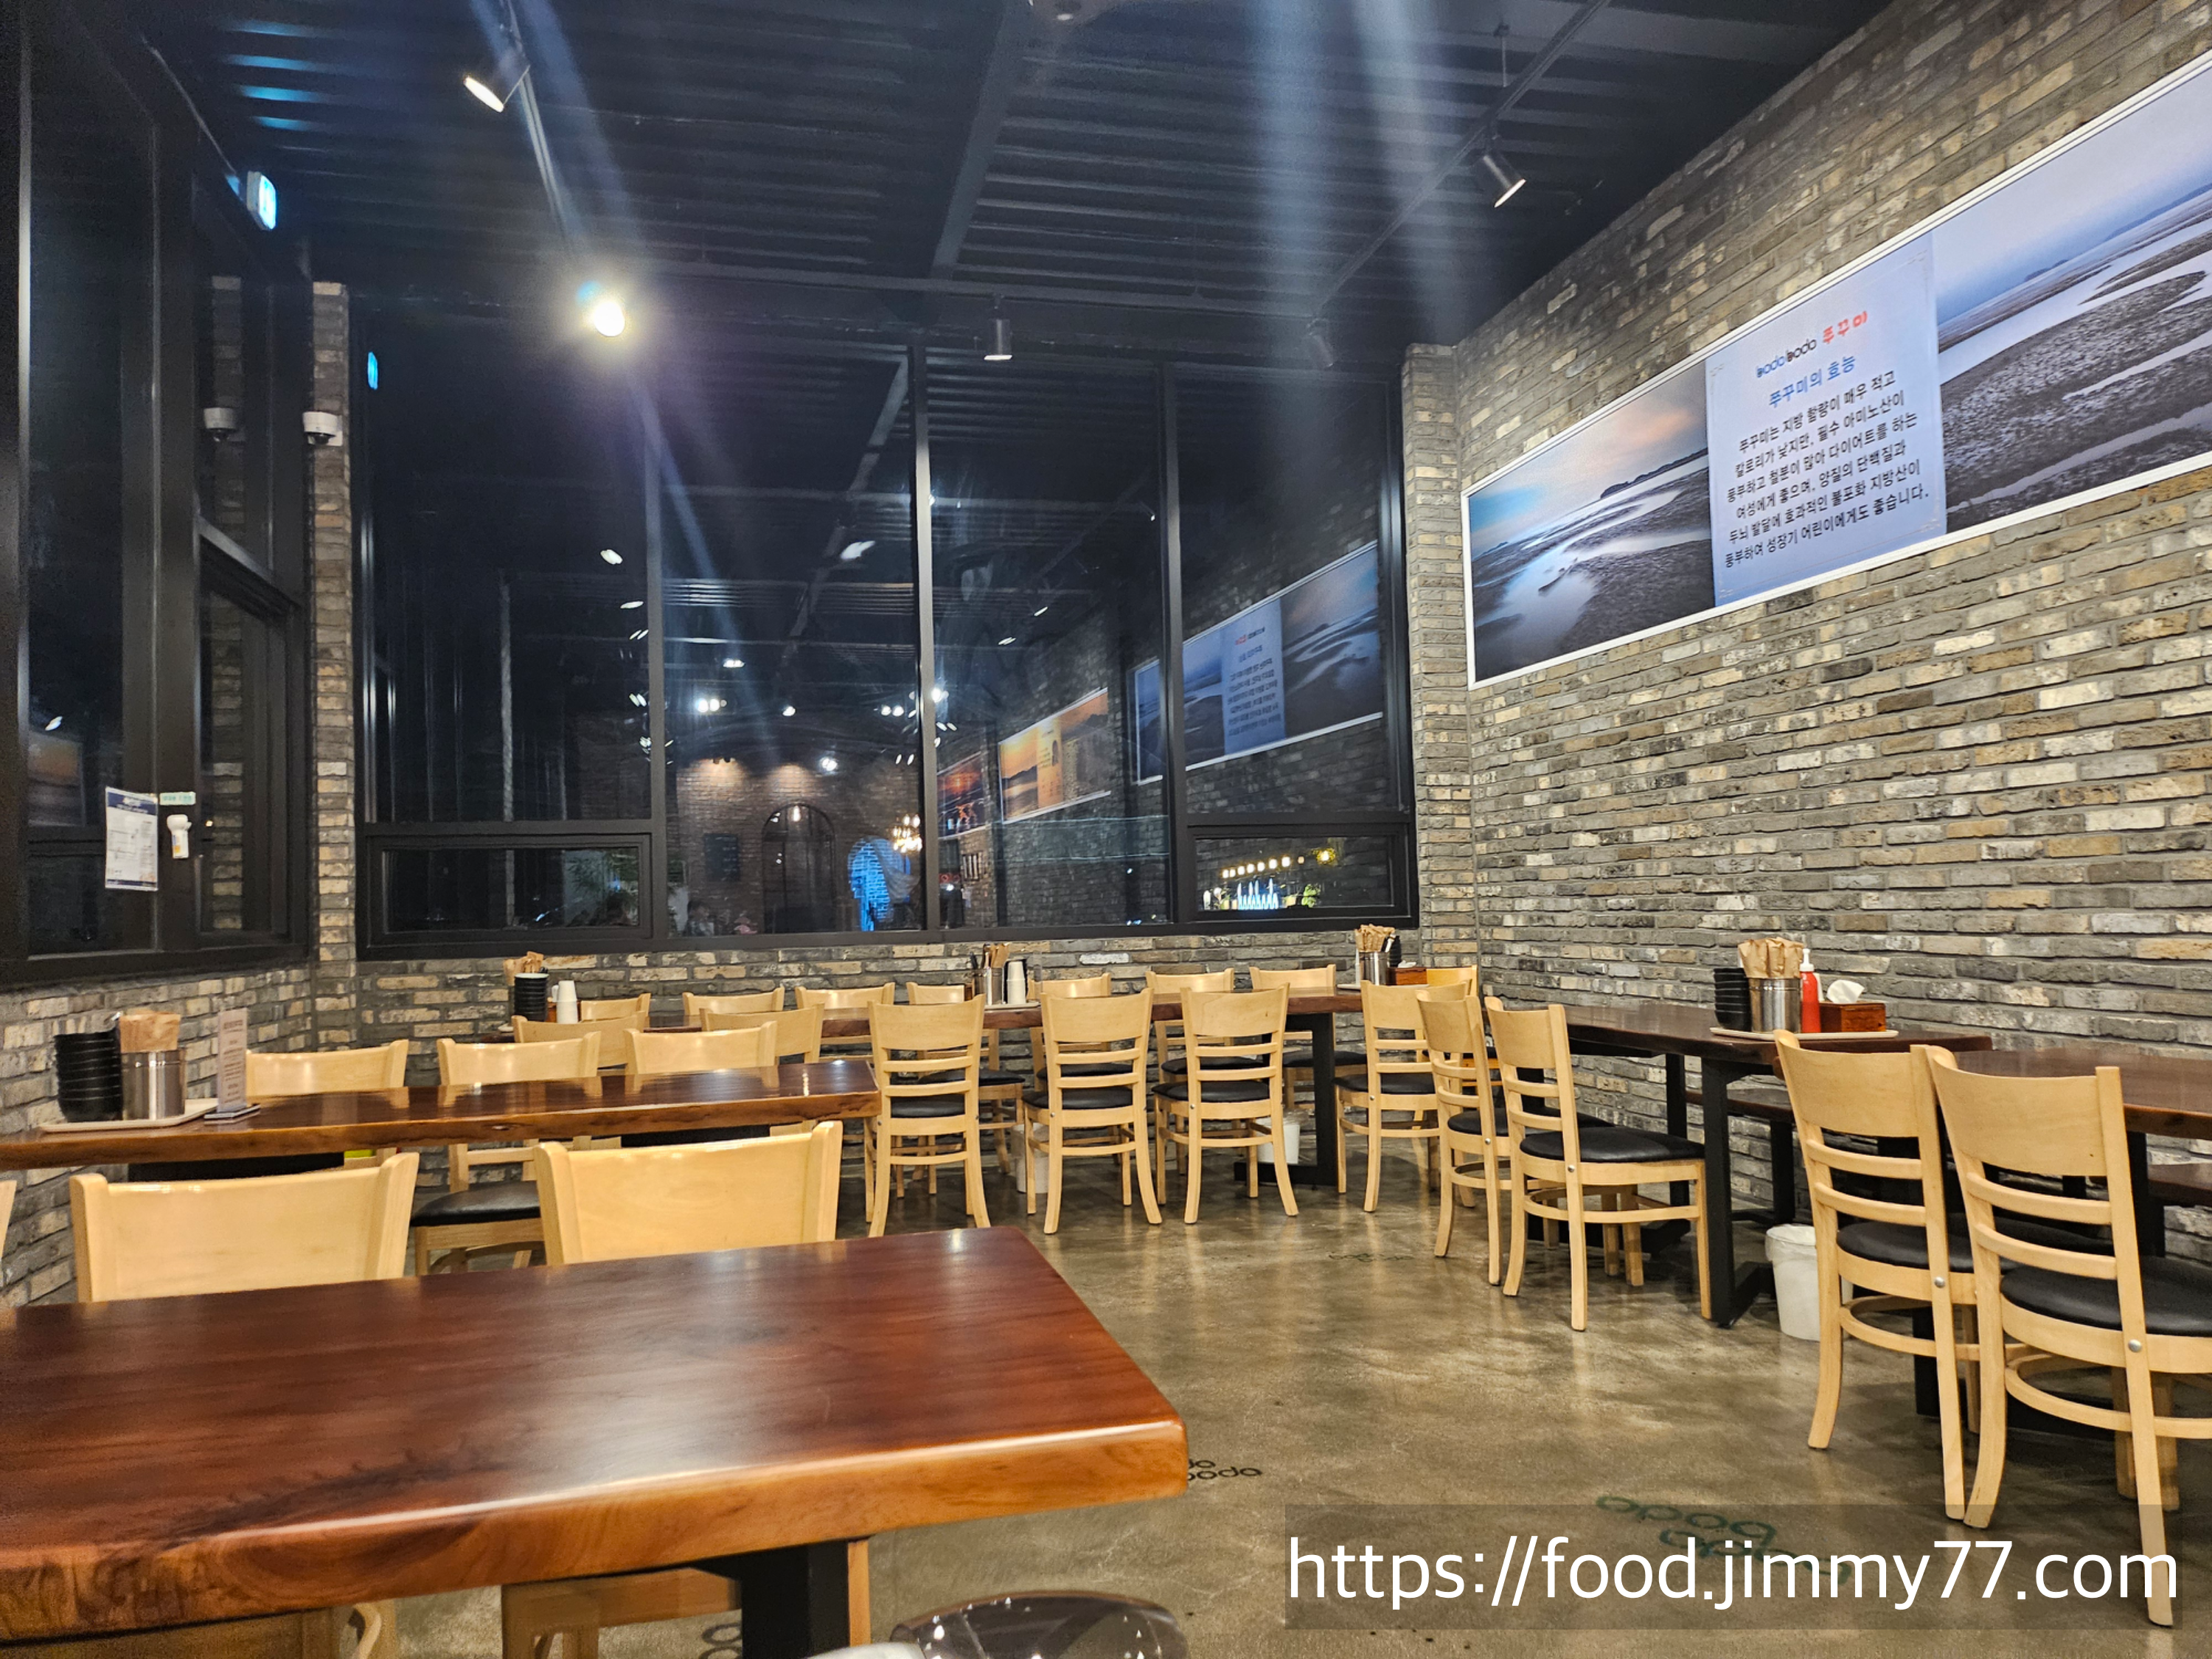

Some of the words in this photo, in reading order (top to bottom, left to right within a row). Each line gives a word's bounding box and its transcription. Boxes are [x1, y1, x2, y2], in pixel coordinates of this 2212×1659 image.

[1783, 413, 1803, 431] 지방
[1808, 394, 1840, 422] 함량이
[1844, 383, 1867, 403] 매우
[1872, 370, 1896, 391] 적고
[1828, 356, 1855, 380] 효능
[1728, 476, 1766, 502] 풍부하고
[1770, 460, 1800, 485] 철분이
[1804, 449, 1825, 470] 많아
[1829, 422, 1888, 458] 다이어트를
[1893, 412, 1917, 431] 하는
[1735, 450, 1774, 477] 칼로리가
[1818, 420, 1840, 442] 필수
[1844, 389, 1905, 428] 아미노산이
[1736, 493, 1775, 518] 여성에게
[1819, 462, 1853, 488] 양질의
[1857, 439, 1906, 473] 단백질과
[1752, 513, 1781, 537] 발달에
[1785, 495, 1828, 524] 효과적인
[1832, 481, 1865, 507] 불포화
[1870, 459, 1920, 490] 지방산이
[1725, 542, 1764, 568] 풍부하여
[1767, 530, 1798, 553] 성장기
[1802, 505, 1870, 539] 어린이에게도
[1874, 484, 1929, 515] 좋습니다.
